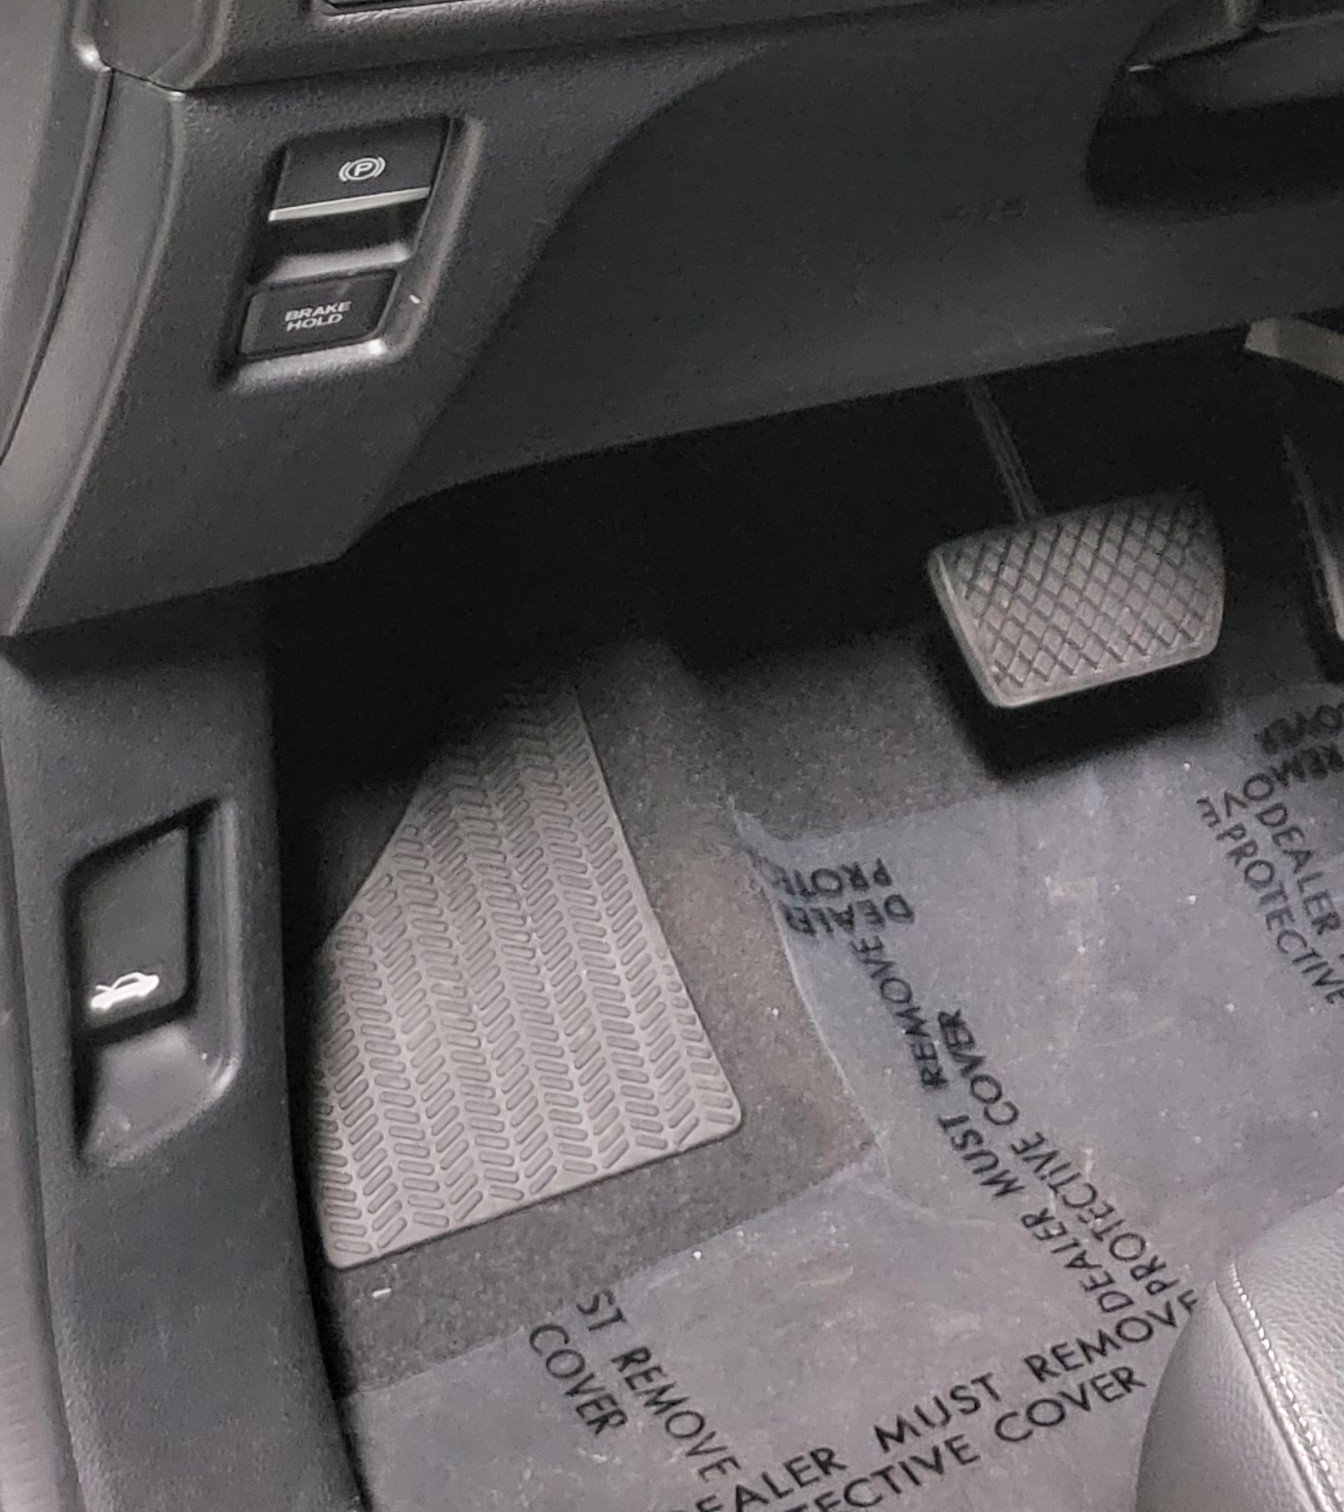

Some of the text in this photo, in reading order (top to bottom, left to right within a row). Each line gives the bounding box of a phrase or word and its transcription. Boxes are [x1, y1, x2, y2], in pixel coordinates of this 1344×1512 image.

[285, 301, 351, 321] BRAKE
[286, 313, 343, 332] HOLD
[1255, 803, 1341, 935] DEALER
[850, 935, 1135, 1314] DEALER MUST REMOVE
[1010, 1131, 1181, 1296] PROTECTIVE
[528, 1323, 628, 1436] COVER
[610, 1346, 742, 1484] REMOVE
[695, 1446, 848, 1512] EALER
[873, 1372, 1000, 1453] MUST
[994, 1366, 1147, 1443] COVER
